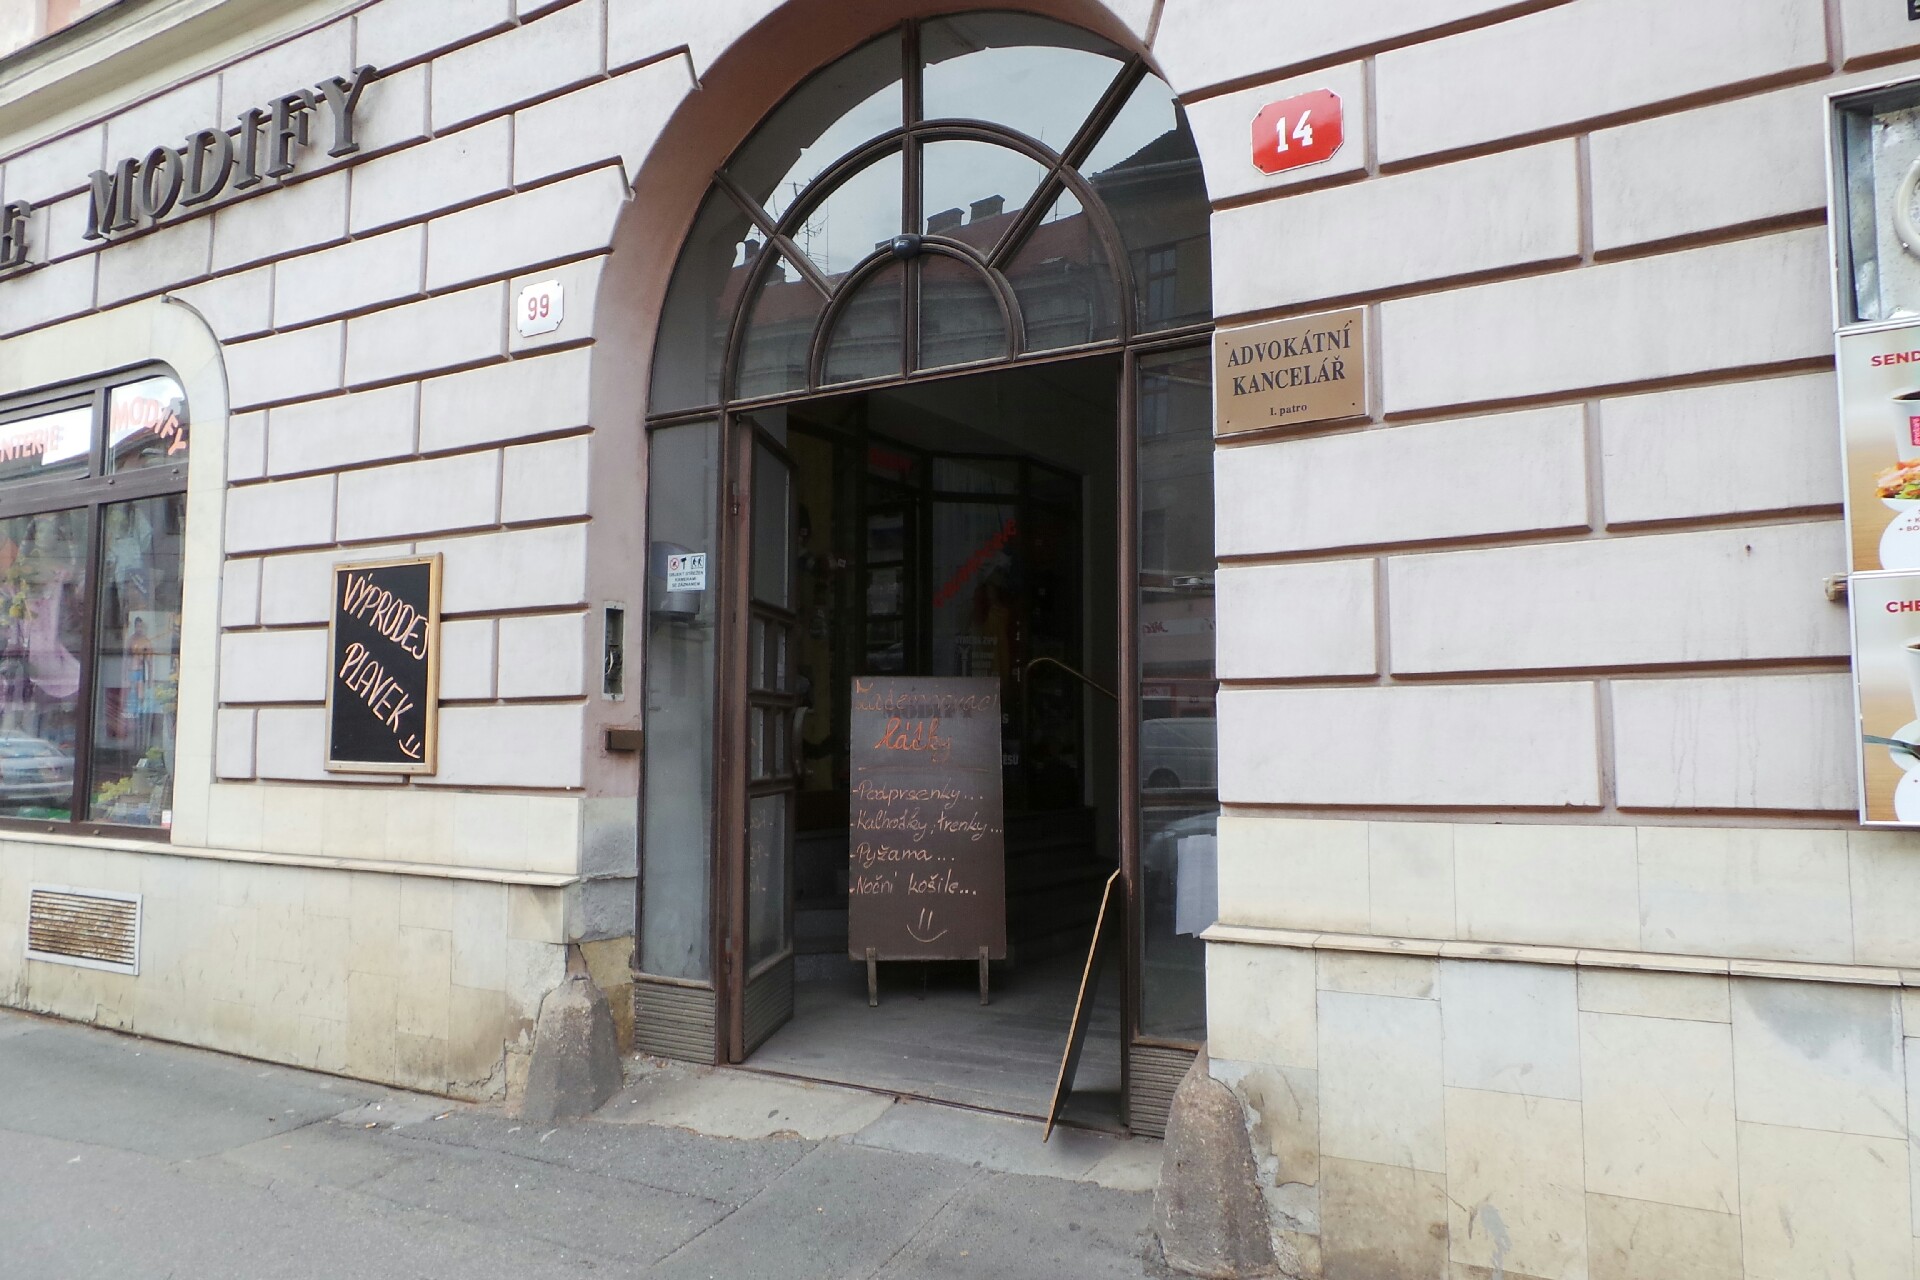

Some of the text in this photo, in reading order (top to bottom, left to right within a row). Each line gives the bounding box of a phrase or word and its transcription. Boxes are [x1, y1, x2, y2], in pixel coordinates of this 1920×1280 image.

[82, 64, 380, 241] MODIFY
[1276, 110, 1313, 153] 14
[528, 294, 549, 320] 99
[1227, 322, 1353, 368] ADVOKÁTNÍ
[1233, 355, 1346, 396] KANCELÁŘ
[1279, 404, 1308, 417] patro
[343, 572, 430, 661] VÝPRODEJ
[338, 642, 415, 734] PLAVEK
